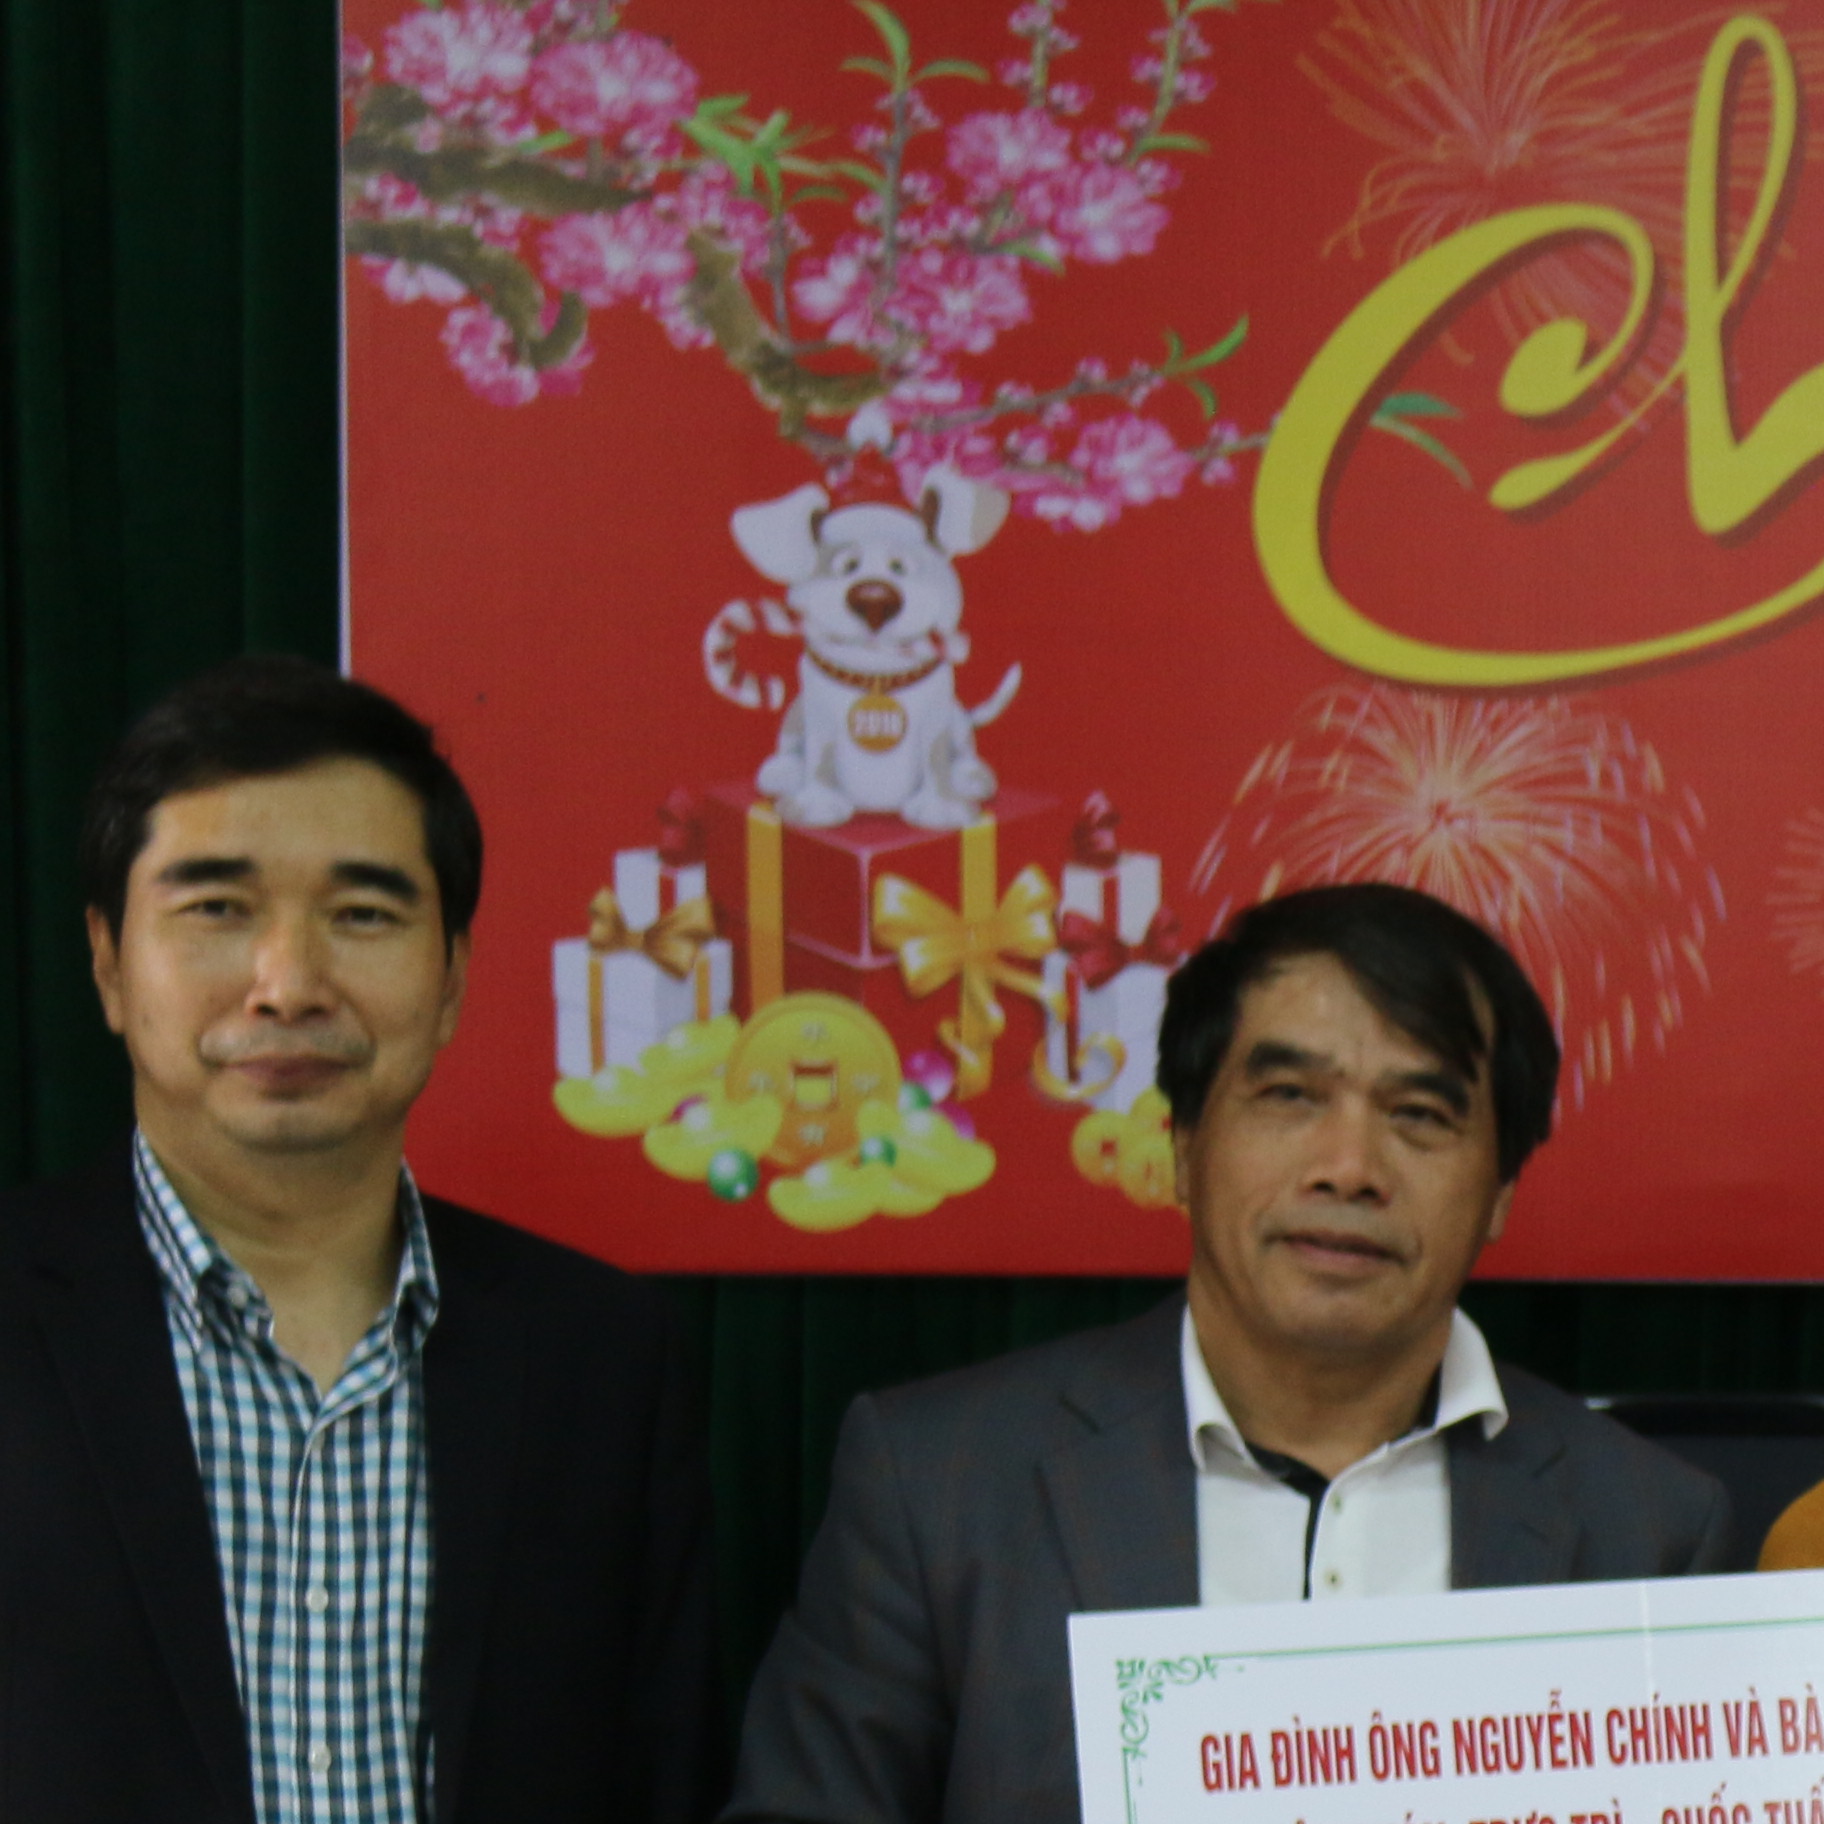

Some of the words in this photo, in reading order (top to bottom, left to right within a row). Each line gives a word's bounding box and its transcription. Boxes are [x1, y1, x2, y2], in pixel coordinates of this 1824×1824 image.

[1200, 1731, 1262, 1793] GIA
[1269, 1715, 1357, 1788] ĐÌNH
[1368, 1709, 1442, 1782] ÔNG
[1452, 1687, 1595, 1777] NGUYỄN
[1605, 1691, 1714, 1766] CHÍNH
[1722, 1684, 1770, 1759] VÀ
